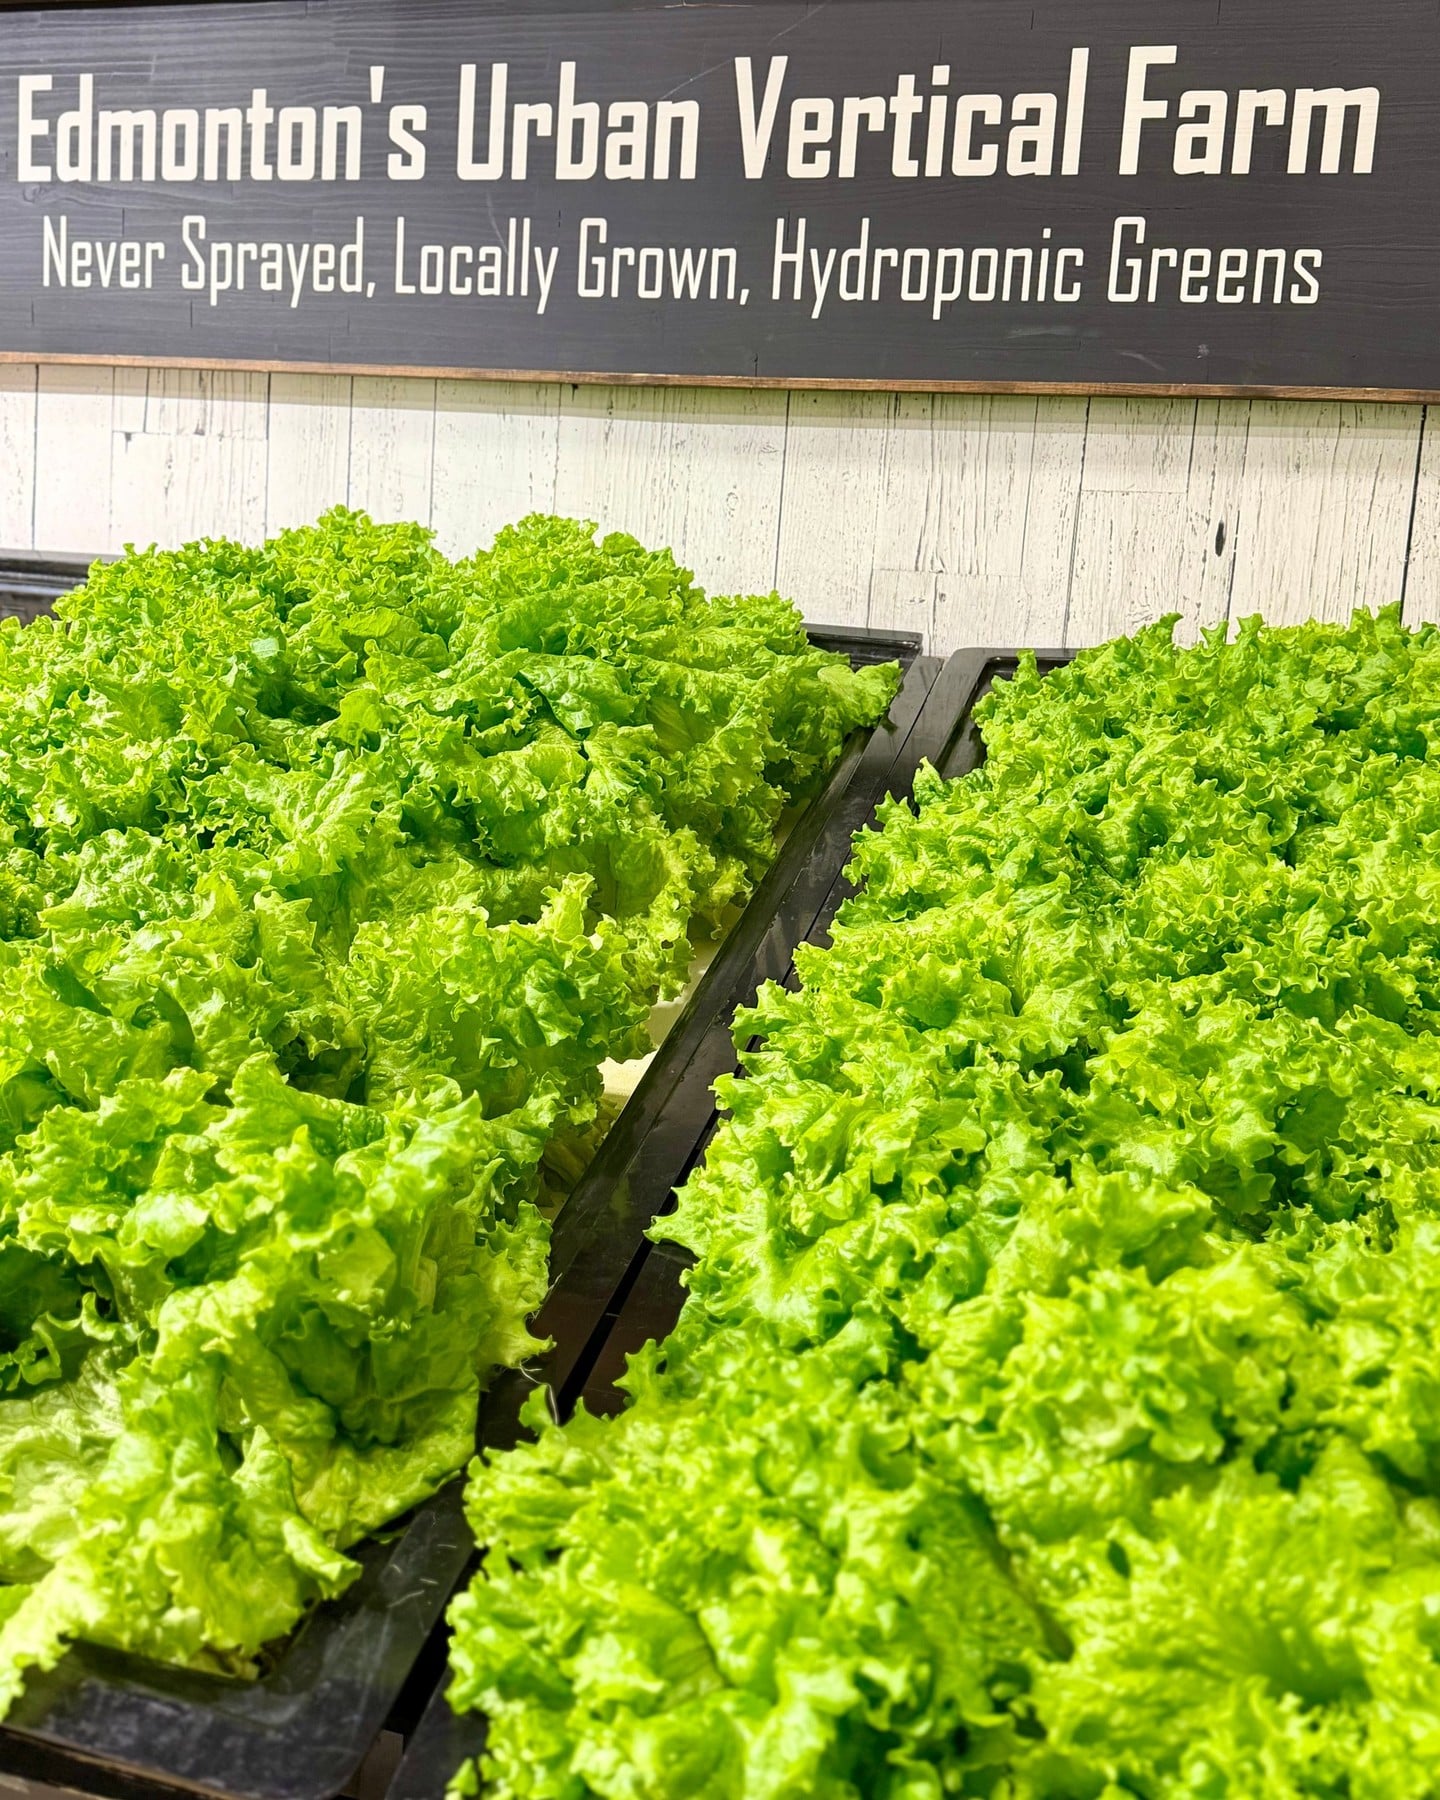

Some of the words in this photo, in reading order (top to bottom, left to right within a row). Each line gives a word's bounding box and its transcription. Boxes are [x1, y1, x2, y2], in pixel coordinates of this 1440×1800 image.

[17, 65, 428, 183] Edmonton's
[456, 60, 700, 181] Urban
[734, 47, 1090, 179] Vertical
[1118, 45, 1380, 175] Farm
[42, 214, 166, 291] Never
[180, 214, 376, 309] Sprayed,
[394, 216, 559, 315] Locally
[577, 216, 750, 306] Grown,
[771, 216, 1084, 321] Hydroponic
[1107, 215, 1323, 304] Greens
